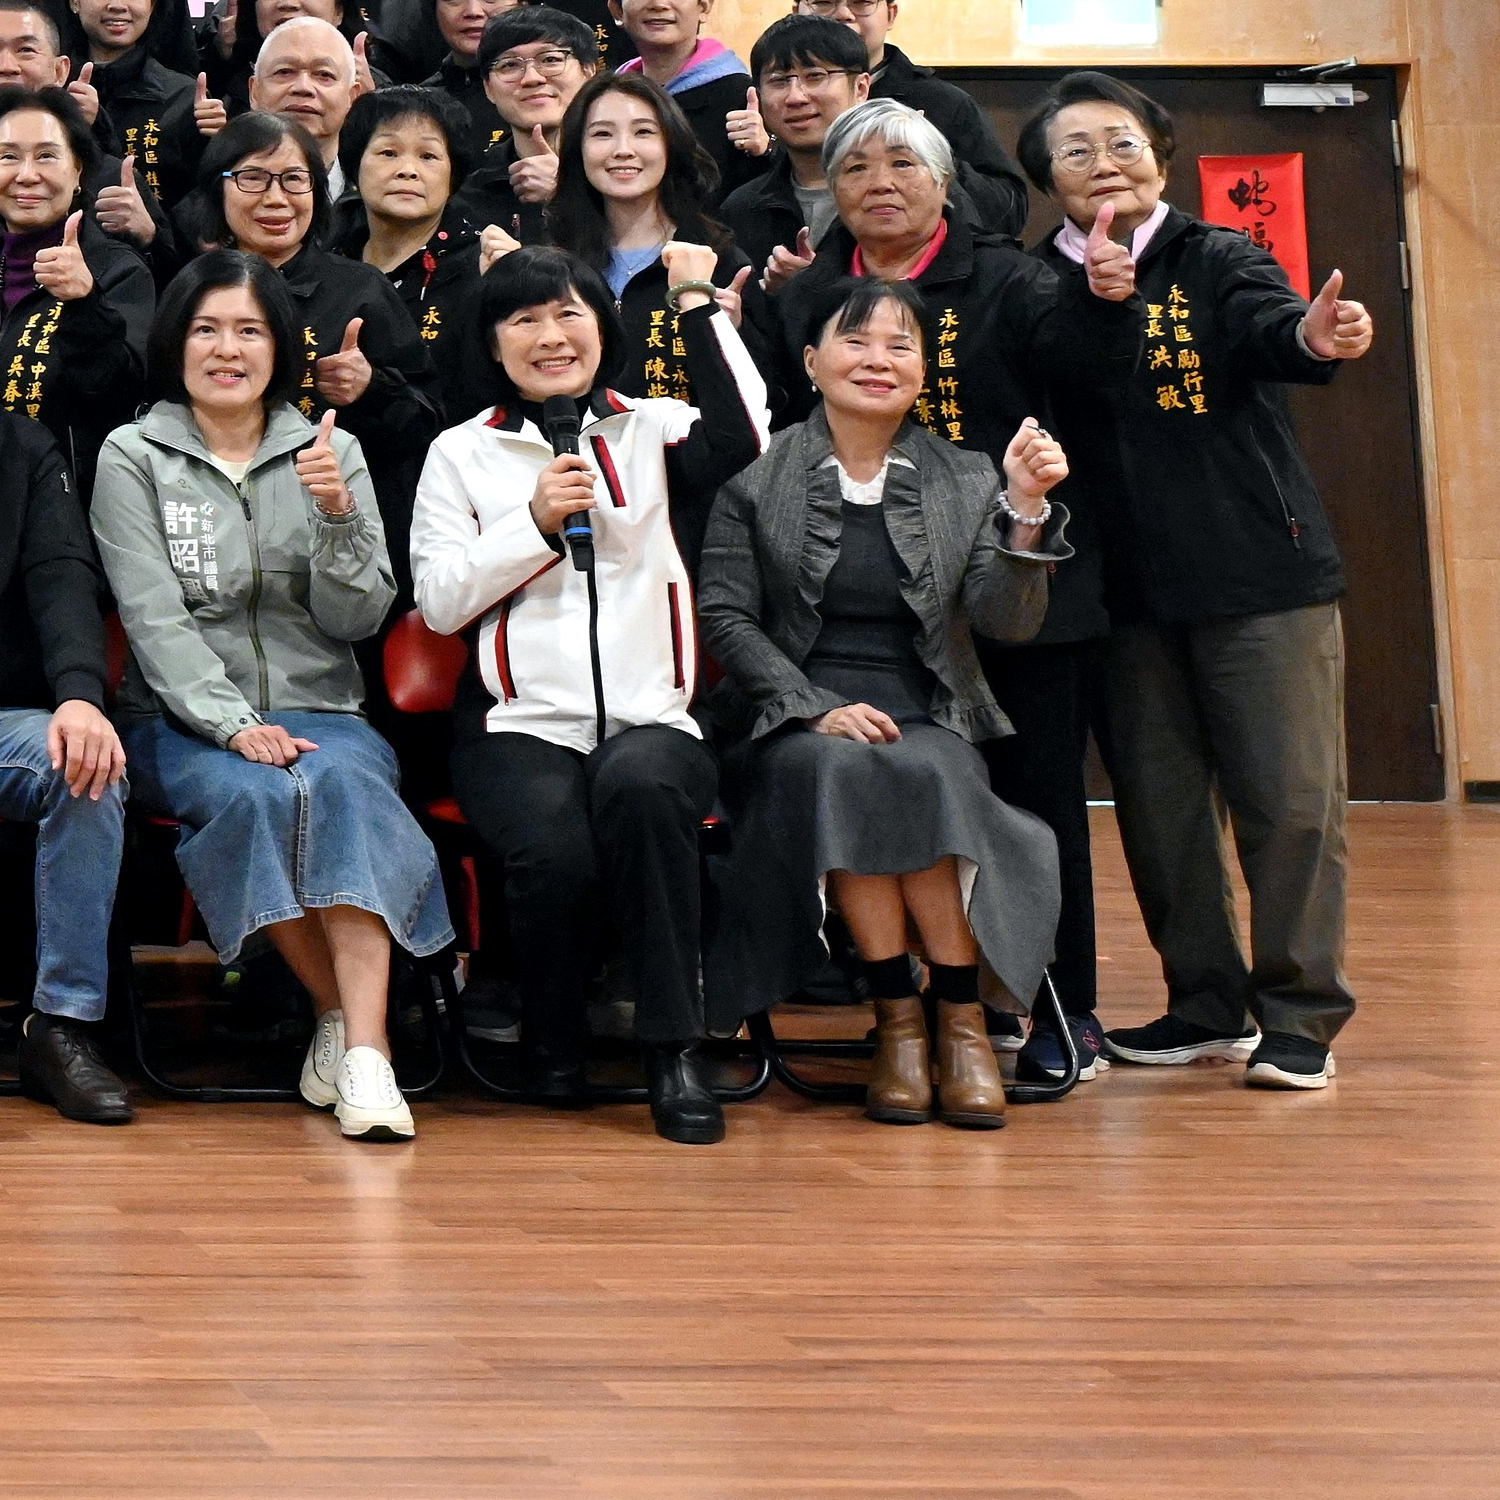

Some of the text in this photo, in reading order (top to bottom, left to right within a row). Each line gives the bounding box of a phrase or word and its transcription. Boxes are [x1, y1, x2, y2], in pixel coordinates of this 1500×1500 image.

[142, 118, 162, 164] 永和區
[16, 312, 42, 348] 里長
[645, 309, 666, 349] 里長
[1143, 303, 1166, 338] 里長
[1167, 283, 1194, 343] 永和區
[937, 308, 965, 442] 永和區 竹林里
[200, 518, 219, 591] 新北市議員
